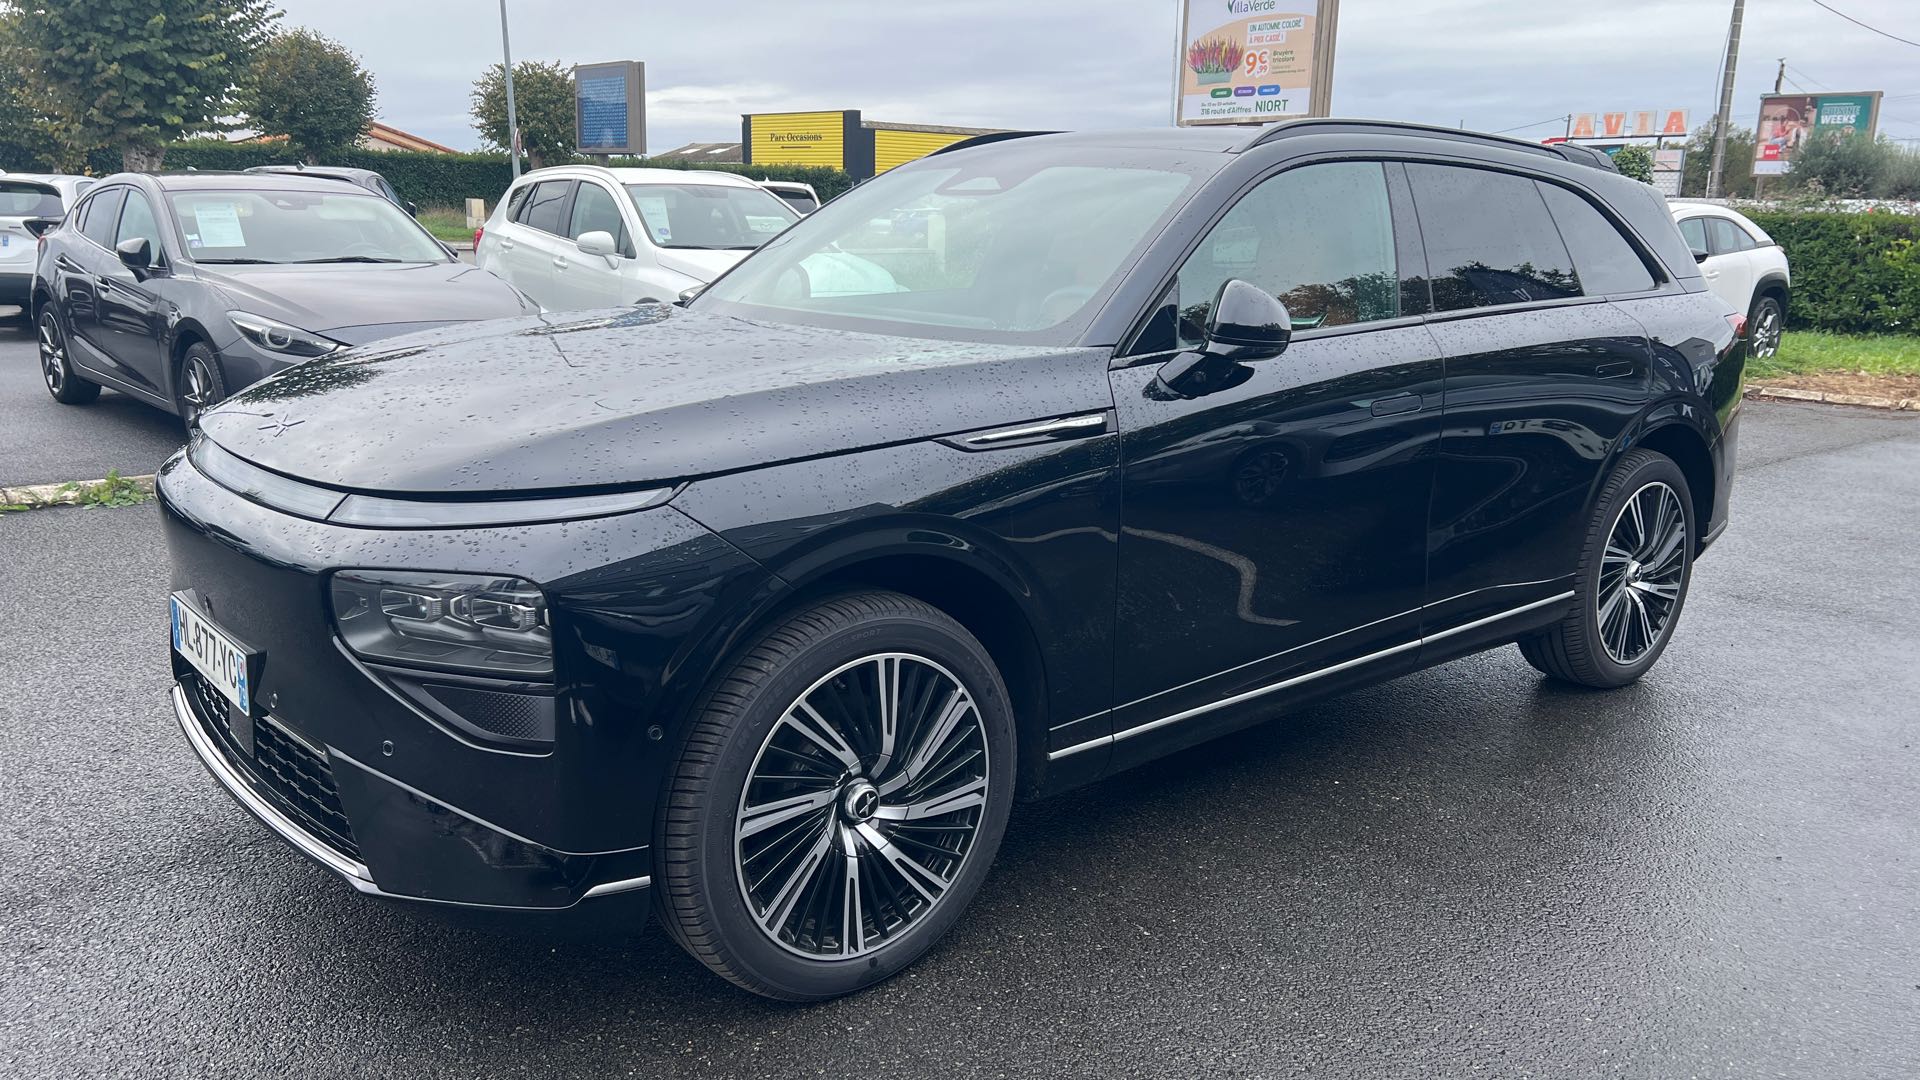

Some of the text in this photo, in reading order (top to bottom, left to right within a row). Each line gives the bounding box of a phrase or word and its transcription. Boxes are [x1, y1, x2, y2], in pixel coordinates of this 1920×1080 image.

[1227, 0, 1276, 14] VillaVerde
[1257, 21, 1281, 31] AUTOMNE
[1210, 106, 1226, 115] route
[1255, 99, 1289, 112] NIORT
[1573, 111, 1686, 136] AVIA
[1821, 114, 1857, 125] WEEKS
[770, 131, 822, 142] Parc Occasions
